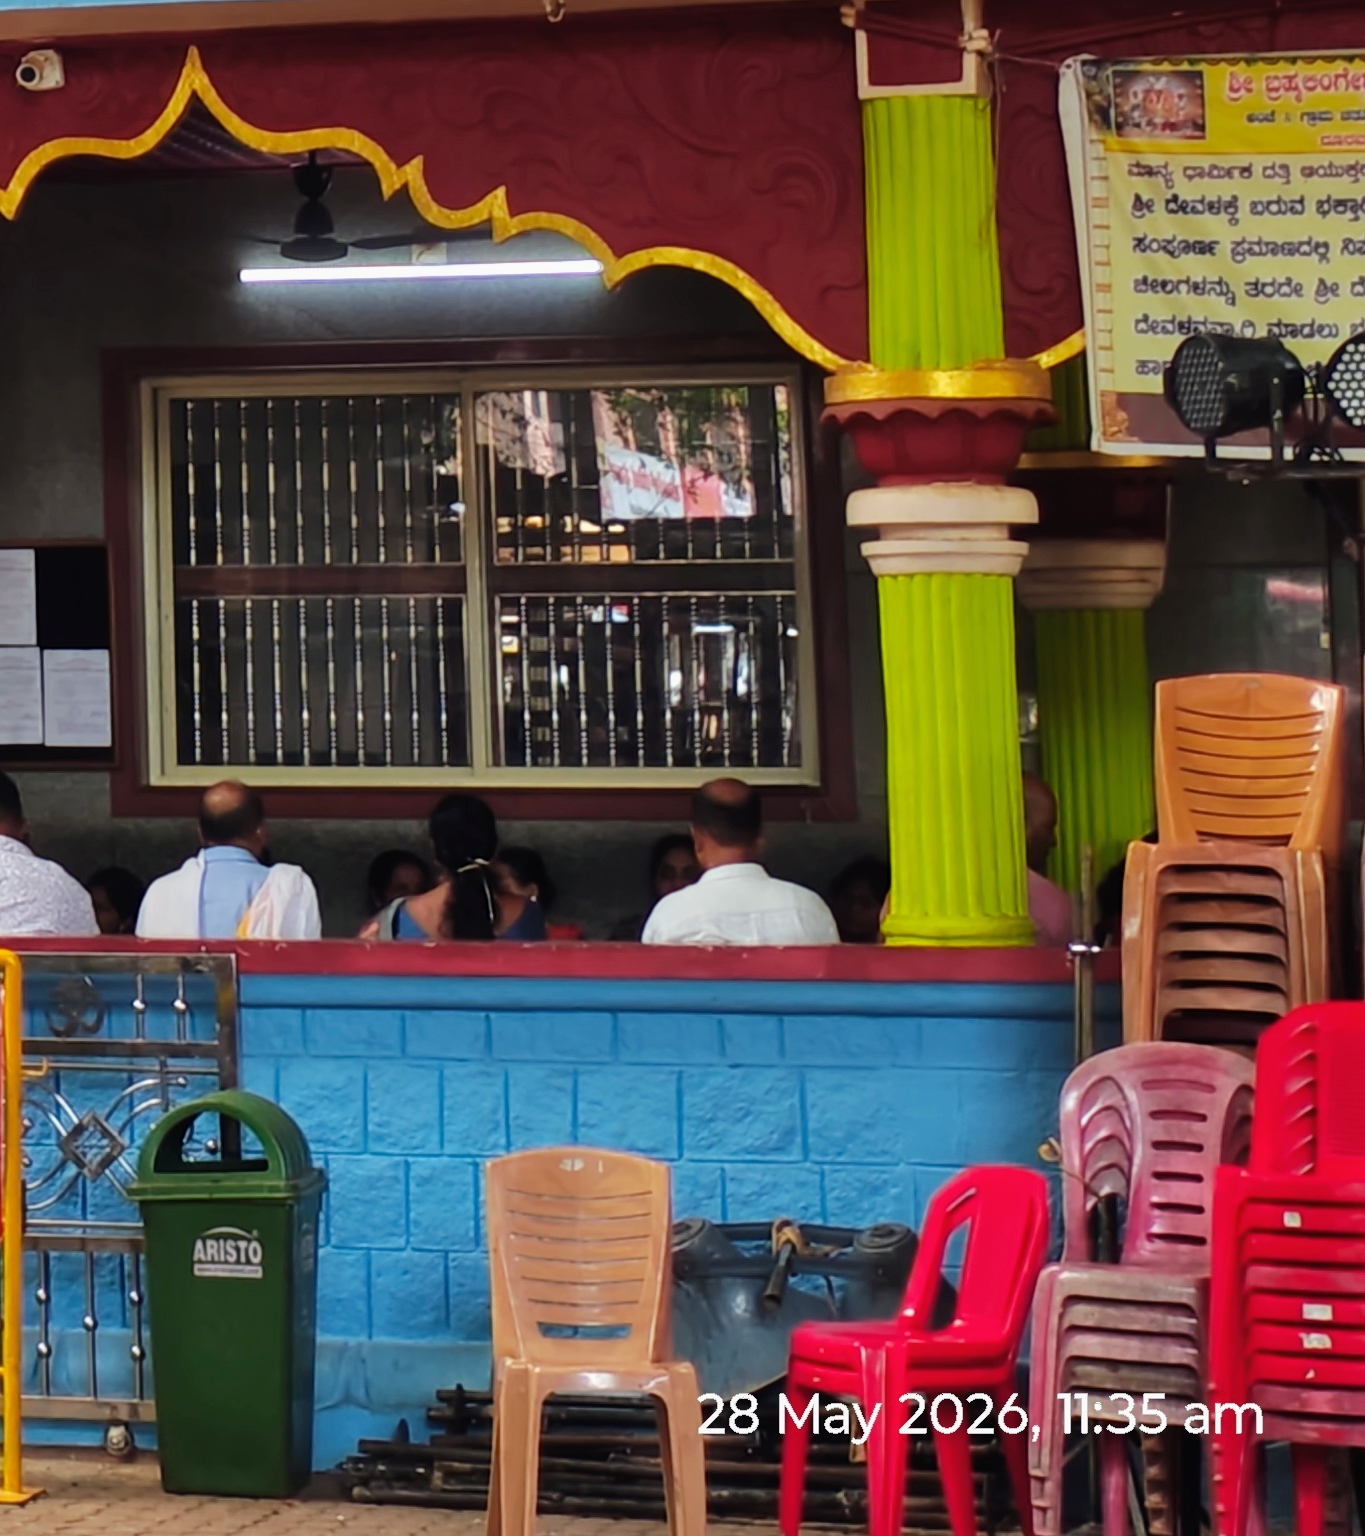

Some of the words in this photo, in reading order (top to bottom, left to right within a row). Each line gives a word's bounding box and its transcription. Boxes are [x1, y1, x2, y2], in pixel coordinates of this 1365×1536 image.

[1228, 70, 1253, 102] ಶ್ರೀ
[1131, 192, 1156, 219] ಶ್ರೀ
[1165, 193, 1240, 226] ದೇವಳಕ್ಕೆ
[1249, 194, 1305, 216] ಬರುವ
[1132, 233, 1220, 259] ಸಂಪೂರ್ಣ
[1230, 236, 1330, 265] ಪ್ರಮಾಣದಲ್ಲಿ
[1244, 276, 1304, 299] ತರದೇ
[1314, 277, 1340, 305] ಶ್ರೀ
[193, 1238, 263, 1264] ARISTO
